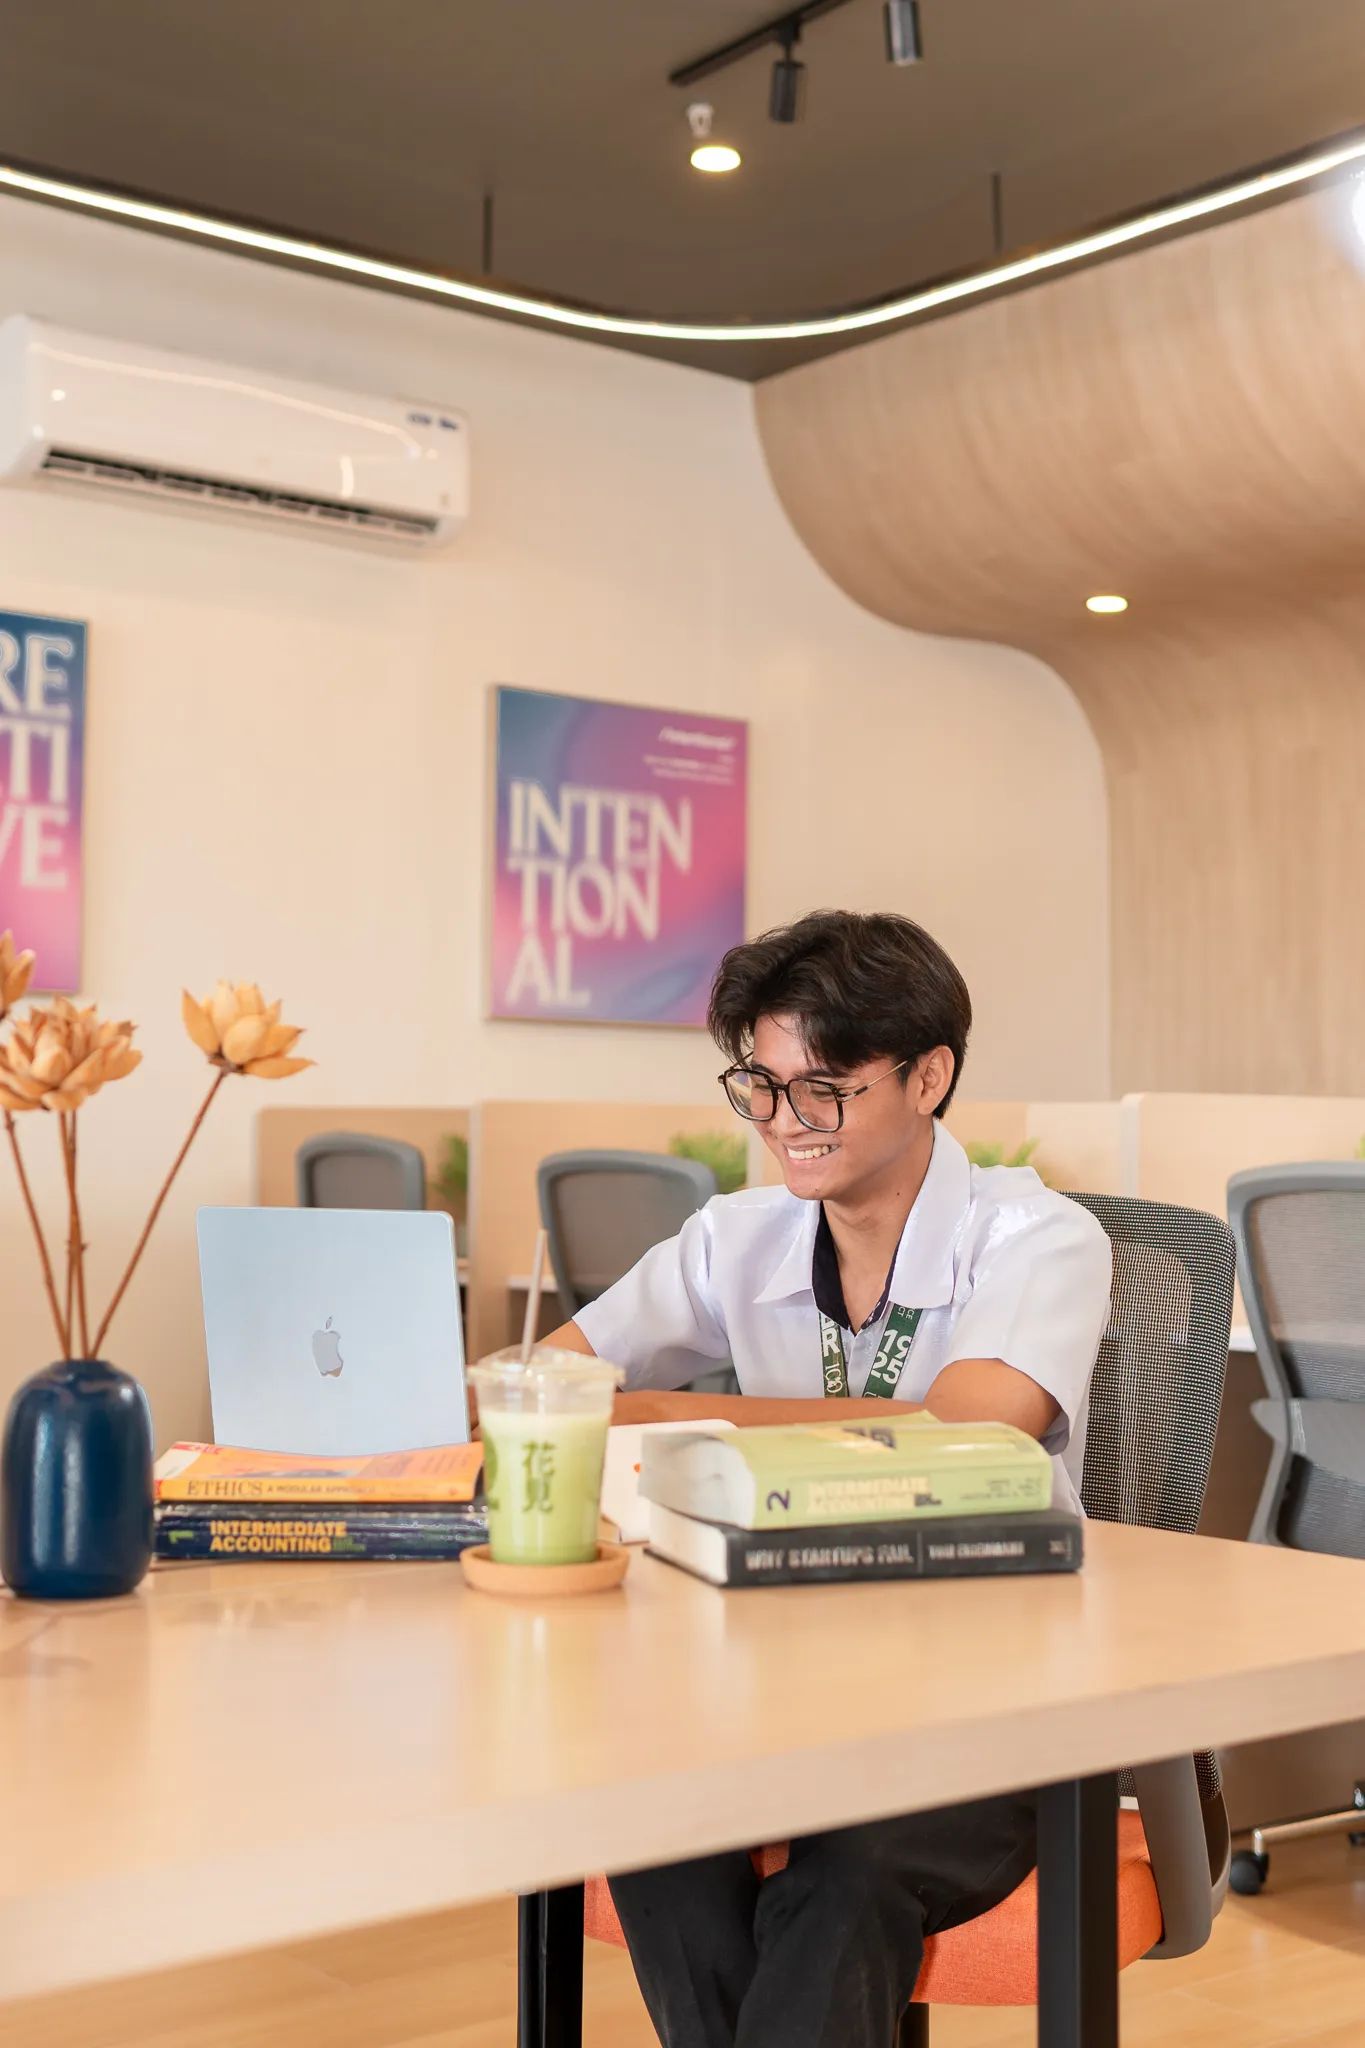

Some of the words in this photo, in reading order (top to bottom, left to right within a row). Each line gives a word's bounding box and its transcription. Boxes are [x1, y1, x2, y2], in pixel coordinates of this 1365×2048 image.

[510, 779, 692, 875] INTEN
[507, 857, 660, 942] TION
[505, 936, 591, 1007] AL
[187, 1479, 263, 1496] ETHICS
[210, 1520, 347, 1537] INTERMEDIATE
[210, 1536, 332, 1553] ACCOUNTING
